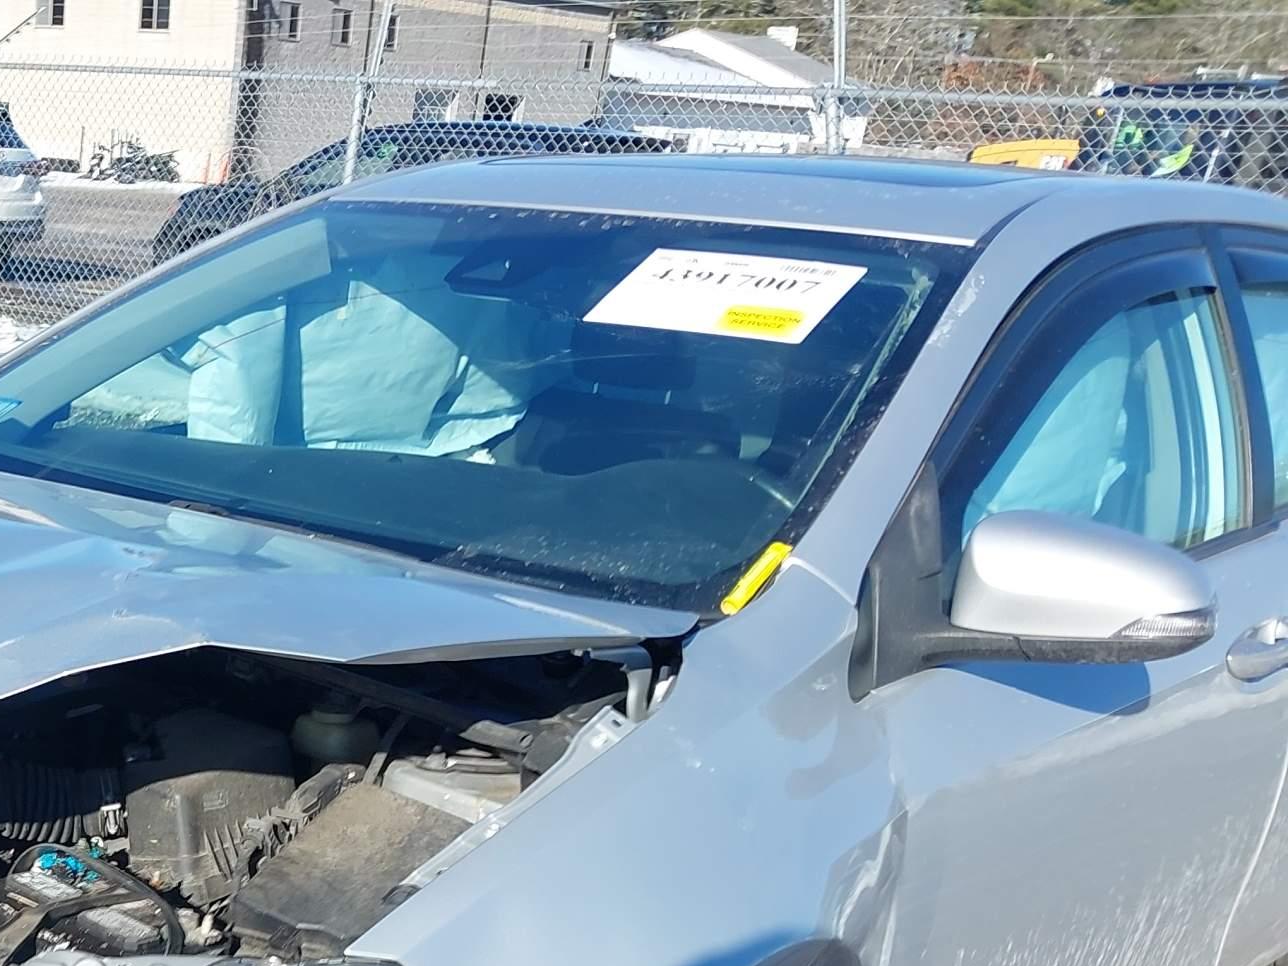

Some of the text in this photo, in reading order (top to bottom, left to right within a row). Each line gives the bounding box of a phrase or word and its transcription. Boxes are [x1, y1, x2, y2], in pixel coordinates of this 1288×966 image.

[651, 267, 822, 295] 43917007
[727, 310, 801, 324] INSPECTION
[730, 318, 787, 330] SERVICE
